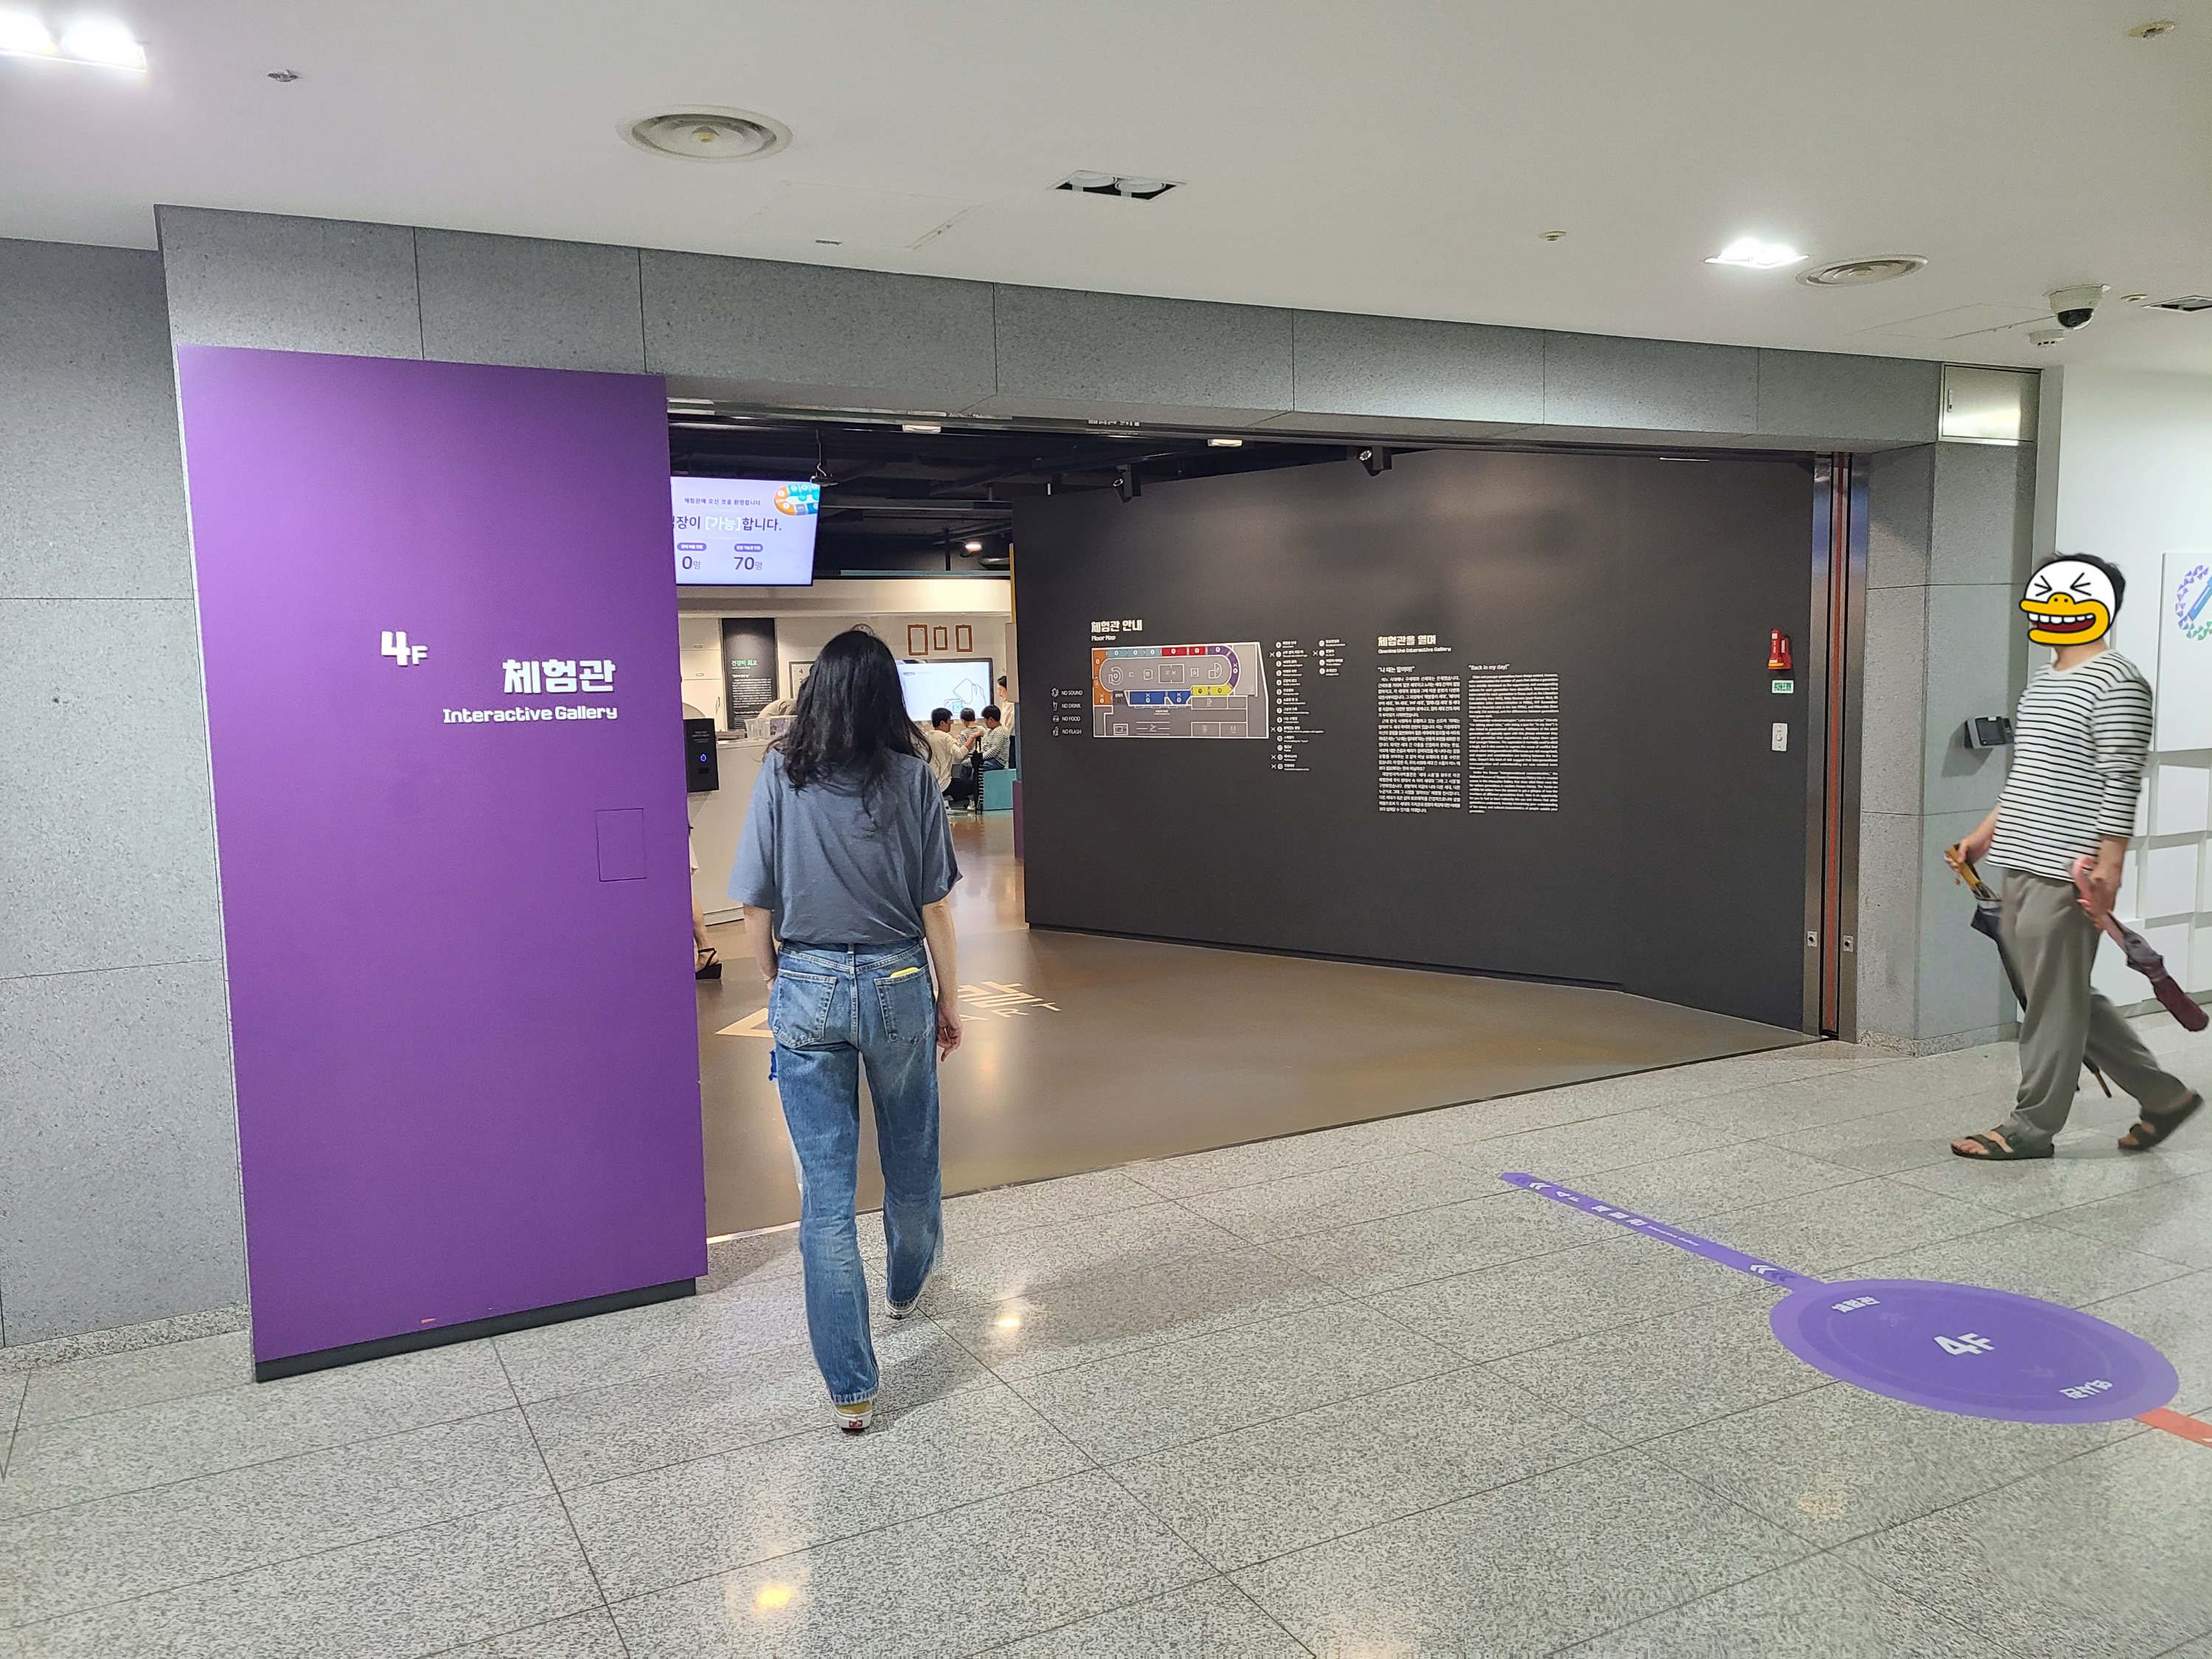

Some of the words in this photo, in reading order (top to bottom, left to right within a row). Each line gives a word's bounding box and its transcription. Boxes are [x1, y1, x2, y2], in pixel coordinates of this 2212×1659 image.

[672, 515, 700, 529] 장이
[705, 516, 782, 532] [가능]합니다.
[1091, 620, 1120, 633] 체험관
[1122, 619, 1143, 632] 안내
[380, 630, 428, 667] 4F
[1377, 636, 1415, 647] 체험관을
[1417, 635, 1436, 645] 열며
[502, 658, 616, 694] 체험관
[443, 706, 553, 724] Interactive
[554, 705, 619, 720] Gallery
[1831, 1295, 1881, 1313] 체험관
[1933, 1332, 1995, 1356] 4F
